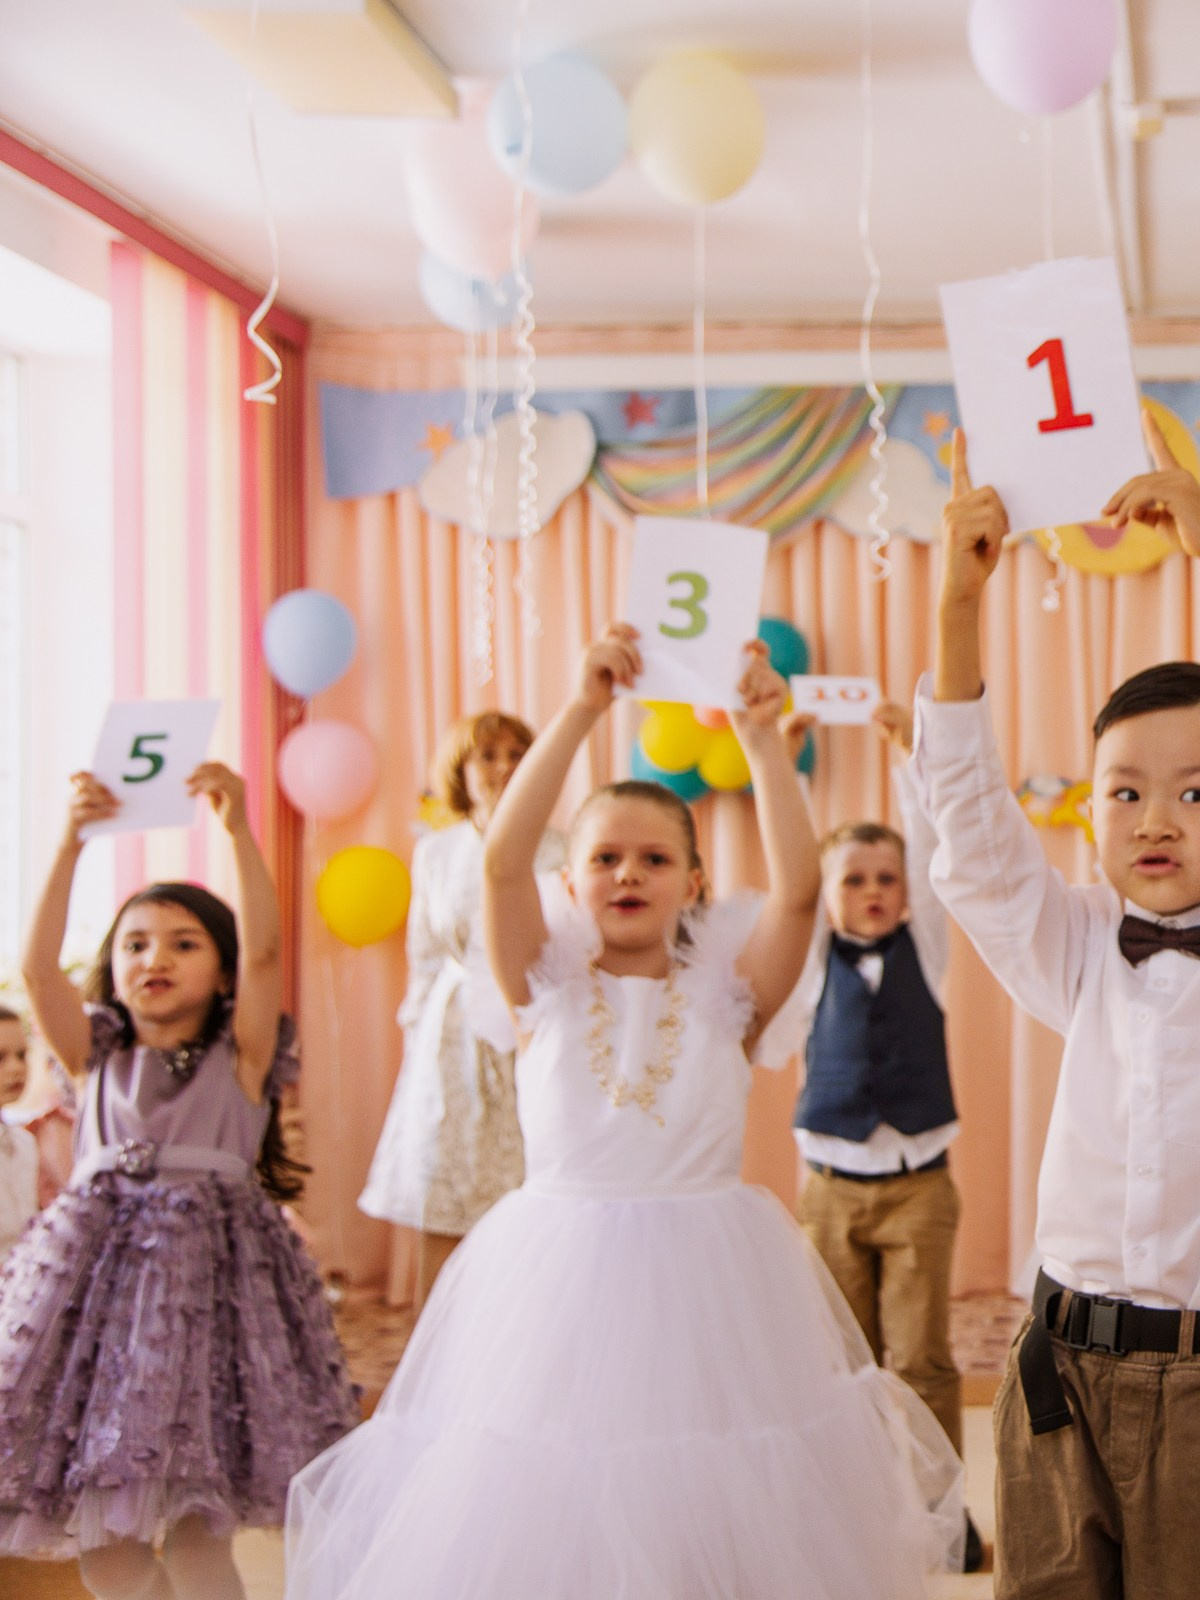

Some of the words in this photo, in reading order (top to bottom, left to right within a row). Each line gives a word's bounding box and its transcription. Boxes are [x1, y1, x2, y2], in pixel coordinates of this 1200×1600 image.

[1027, 338, 1095, 434] 1
[659, 571, 710, 638] 3
[810, 686, 869, 704] 10
[121, 734, 169, 782] 5
